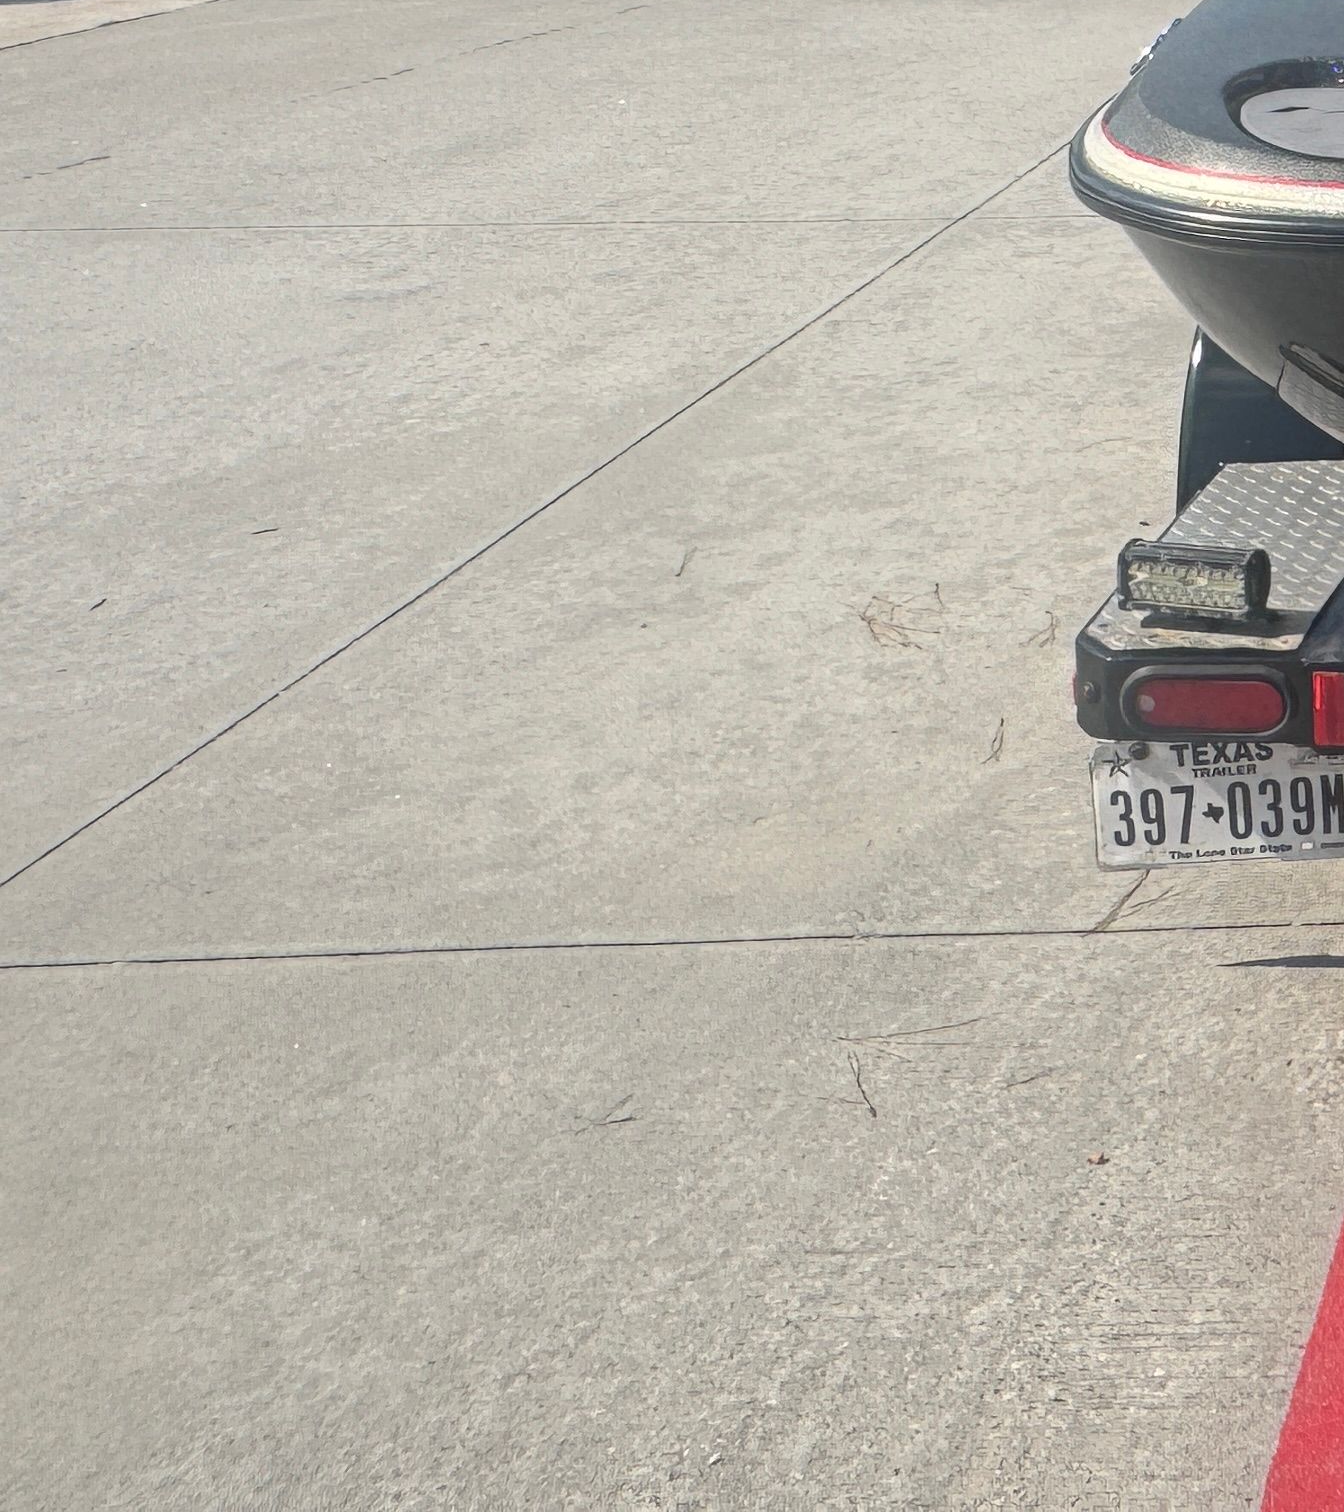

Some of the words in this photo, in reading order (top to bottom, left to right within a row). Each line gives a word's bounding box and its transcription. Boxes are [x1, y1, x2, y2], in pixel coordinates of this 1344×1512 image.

[1169, 742, 1274, 767] TEXAS
[1192, 764, 1257, 778] TRAILER
[1110, 785, 1194, 846] 397
